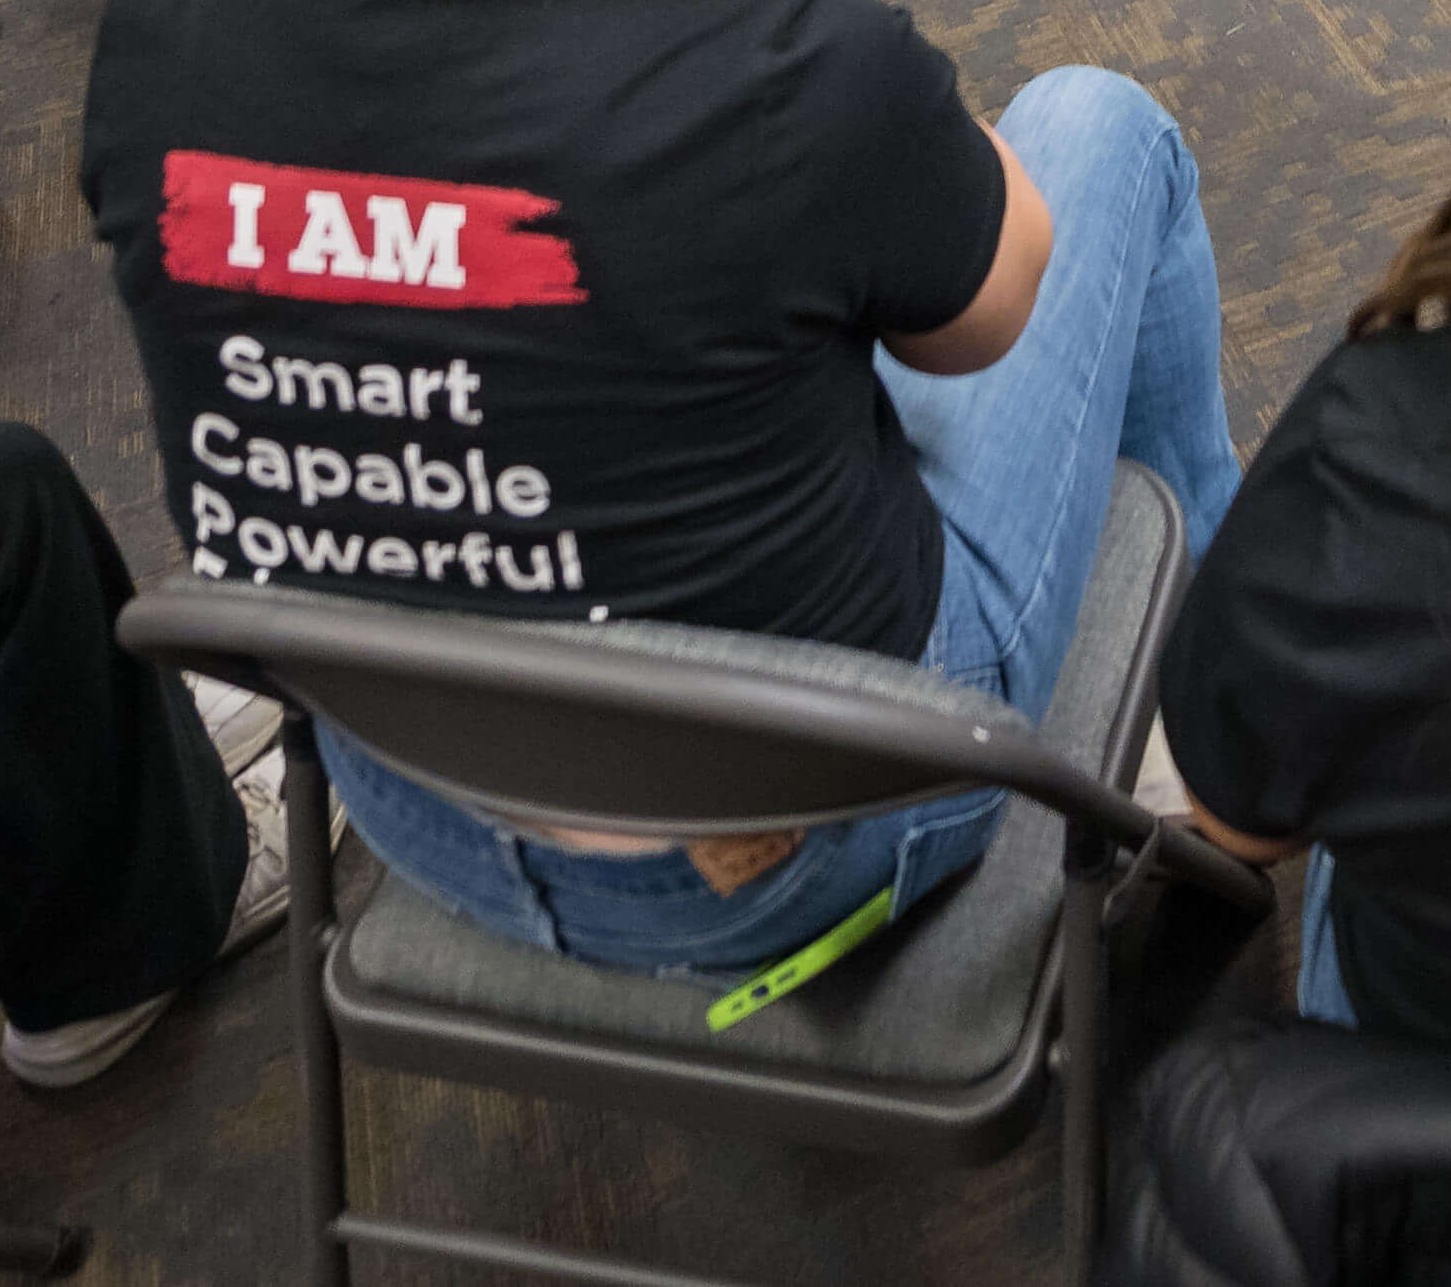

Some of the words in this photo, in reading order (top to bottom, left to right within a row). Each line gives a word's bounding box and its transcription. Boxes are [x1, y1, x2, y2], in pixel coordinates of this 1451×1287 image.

[227, 182, 266, 269] I
[287, 190, 467, 290] AM
[219, 334, 483, 426] Smart
[190, 411, 550, 519] Capable
[192, 480, 584, 592] Powerful
